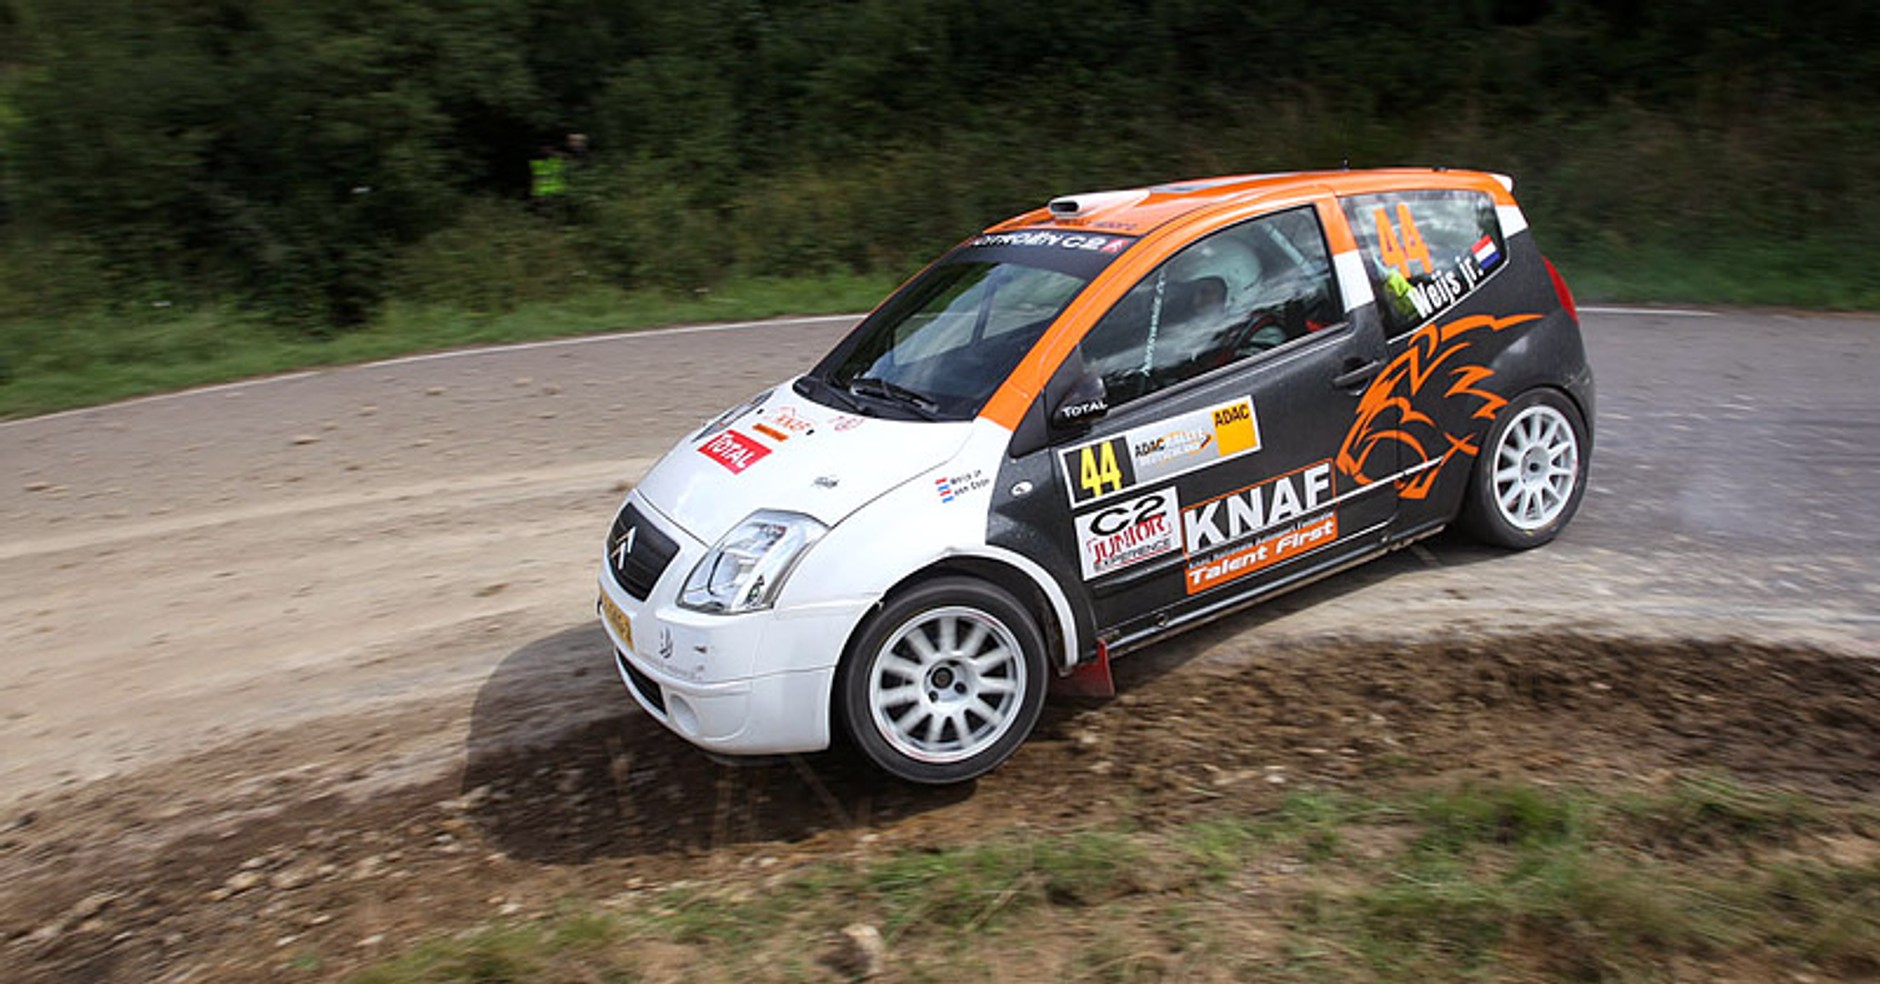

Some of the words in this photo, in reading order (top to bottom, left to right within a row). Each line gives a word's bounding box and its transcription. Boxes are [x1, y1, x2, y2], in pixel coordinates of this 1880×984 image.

[1062, 235, 1106, 250] C2
[1373, 202, 1434, 279] 44
[1406, 269, 1461, 319] Weijs
[1061, 400, 1108, 418] TOTAL
[1214, 403, 1250, 428] ADAC
[707, 431, 757, 469] TOTAL
[1081, 440, 1122, 496] 44
[1134, 436, 1166, 458] ADAC
[1089, 495, 1167, 537] C2
[1184, 462, 1330, 555] KNAF
[1092, 514, 1166, 565] JUNIOR
[1188, 545, 1269, 586] Talent
[1275, 520, 1334, 556] First
